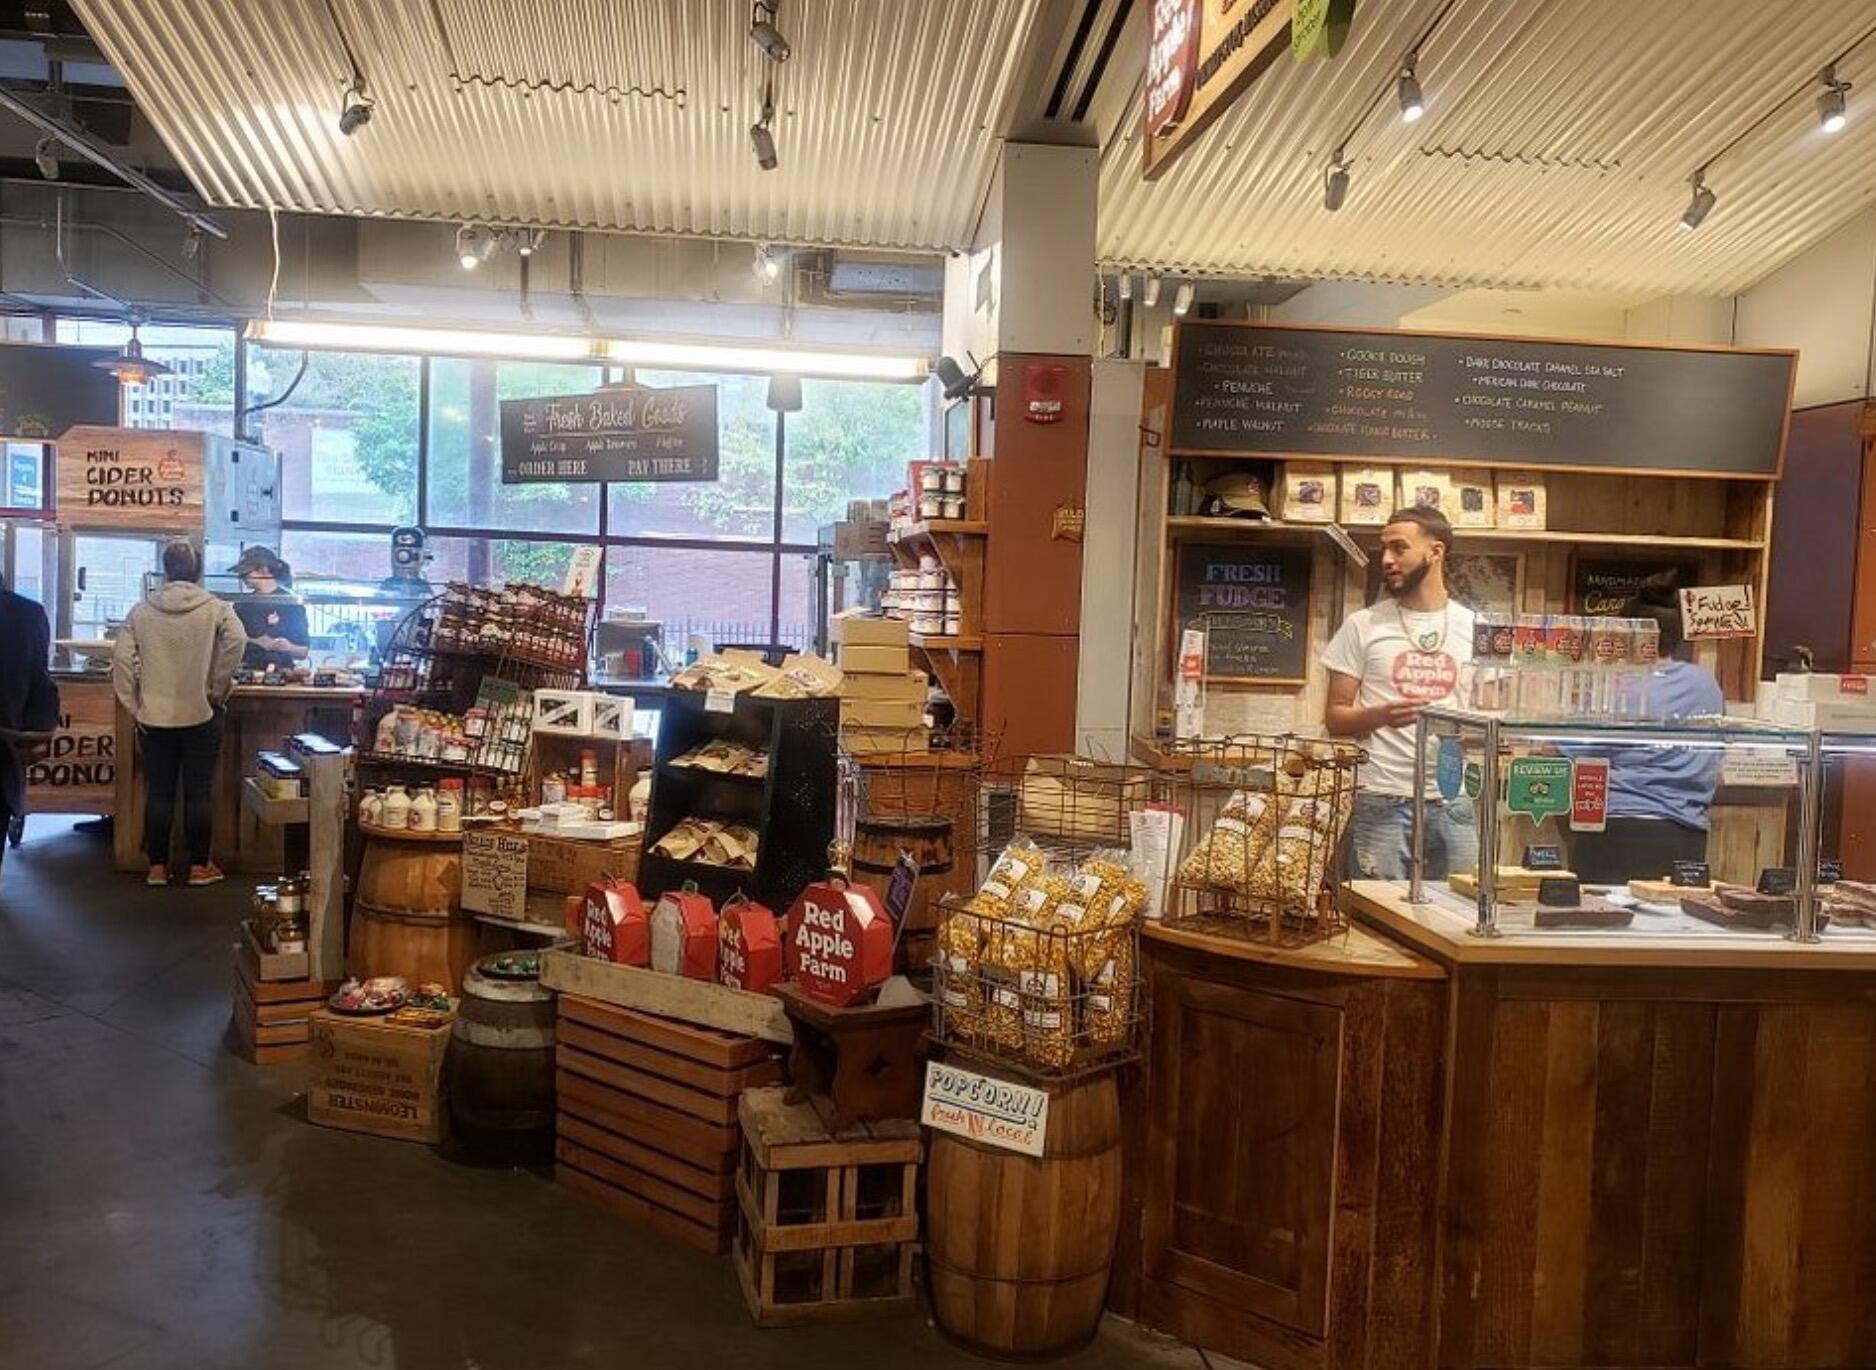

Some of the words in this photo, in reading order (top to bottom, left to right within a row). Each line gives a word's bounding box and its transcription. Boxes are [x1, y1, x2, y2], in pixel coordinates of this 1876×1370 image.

[87, 450, 120, 462] MINI
[87, 466, 152, 485] CIDER
[87, 486, 185, 506] DONUTS
[1206, 564, 1281, 582] FRESH
[1199, 584, 1287, 610] FUDGE
[803, 901, 845, 933] Red
[795, 923, 854, 959] Apple
[800, 952, 847, 983] Farm
